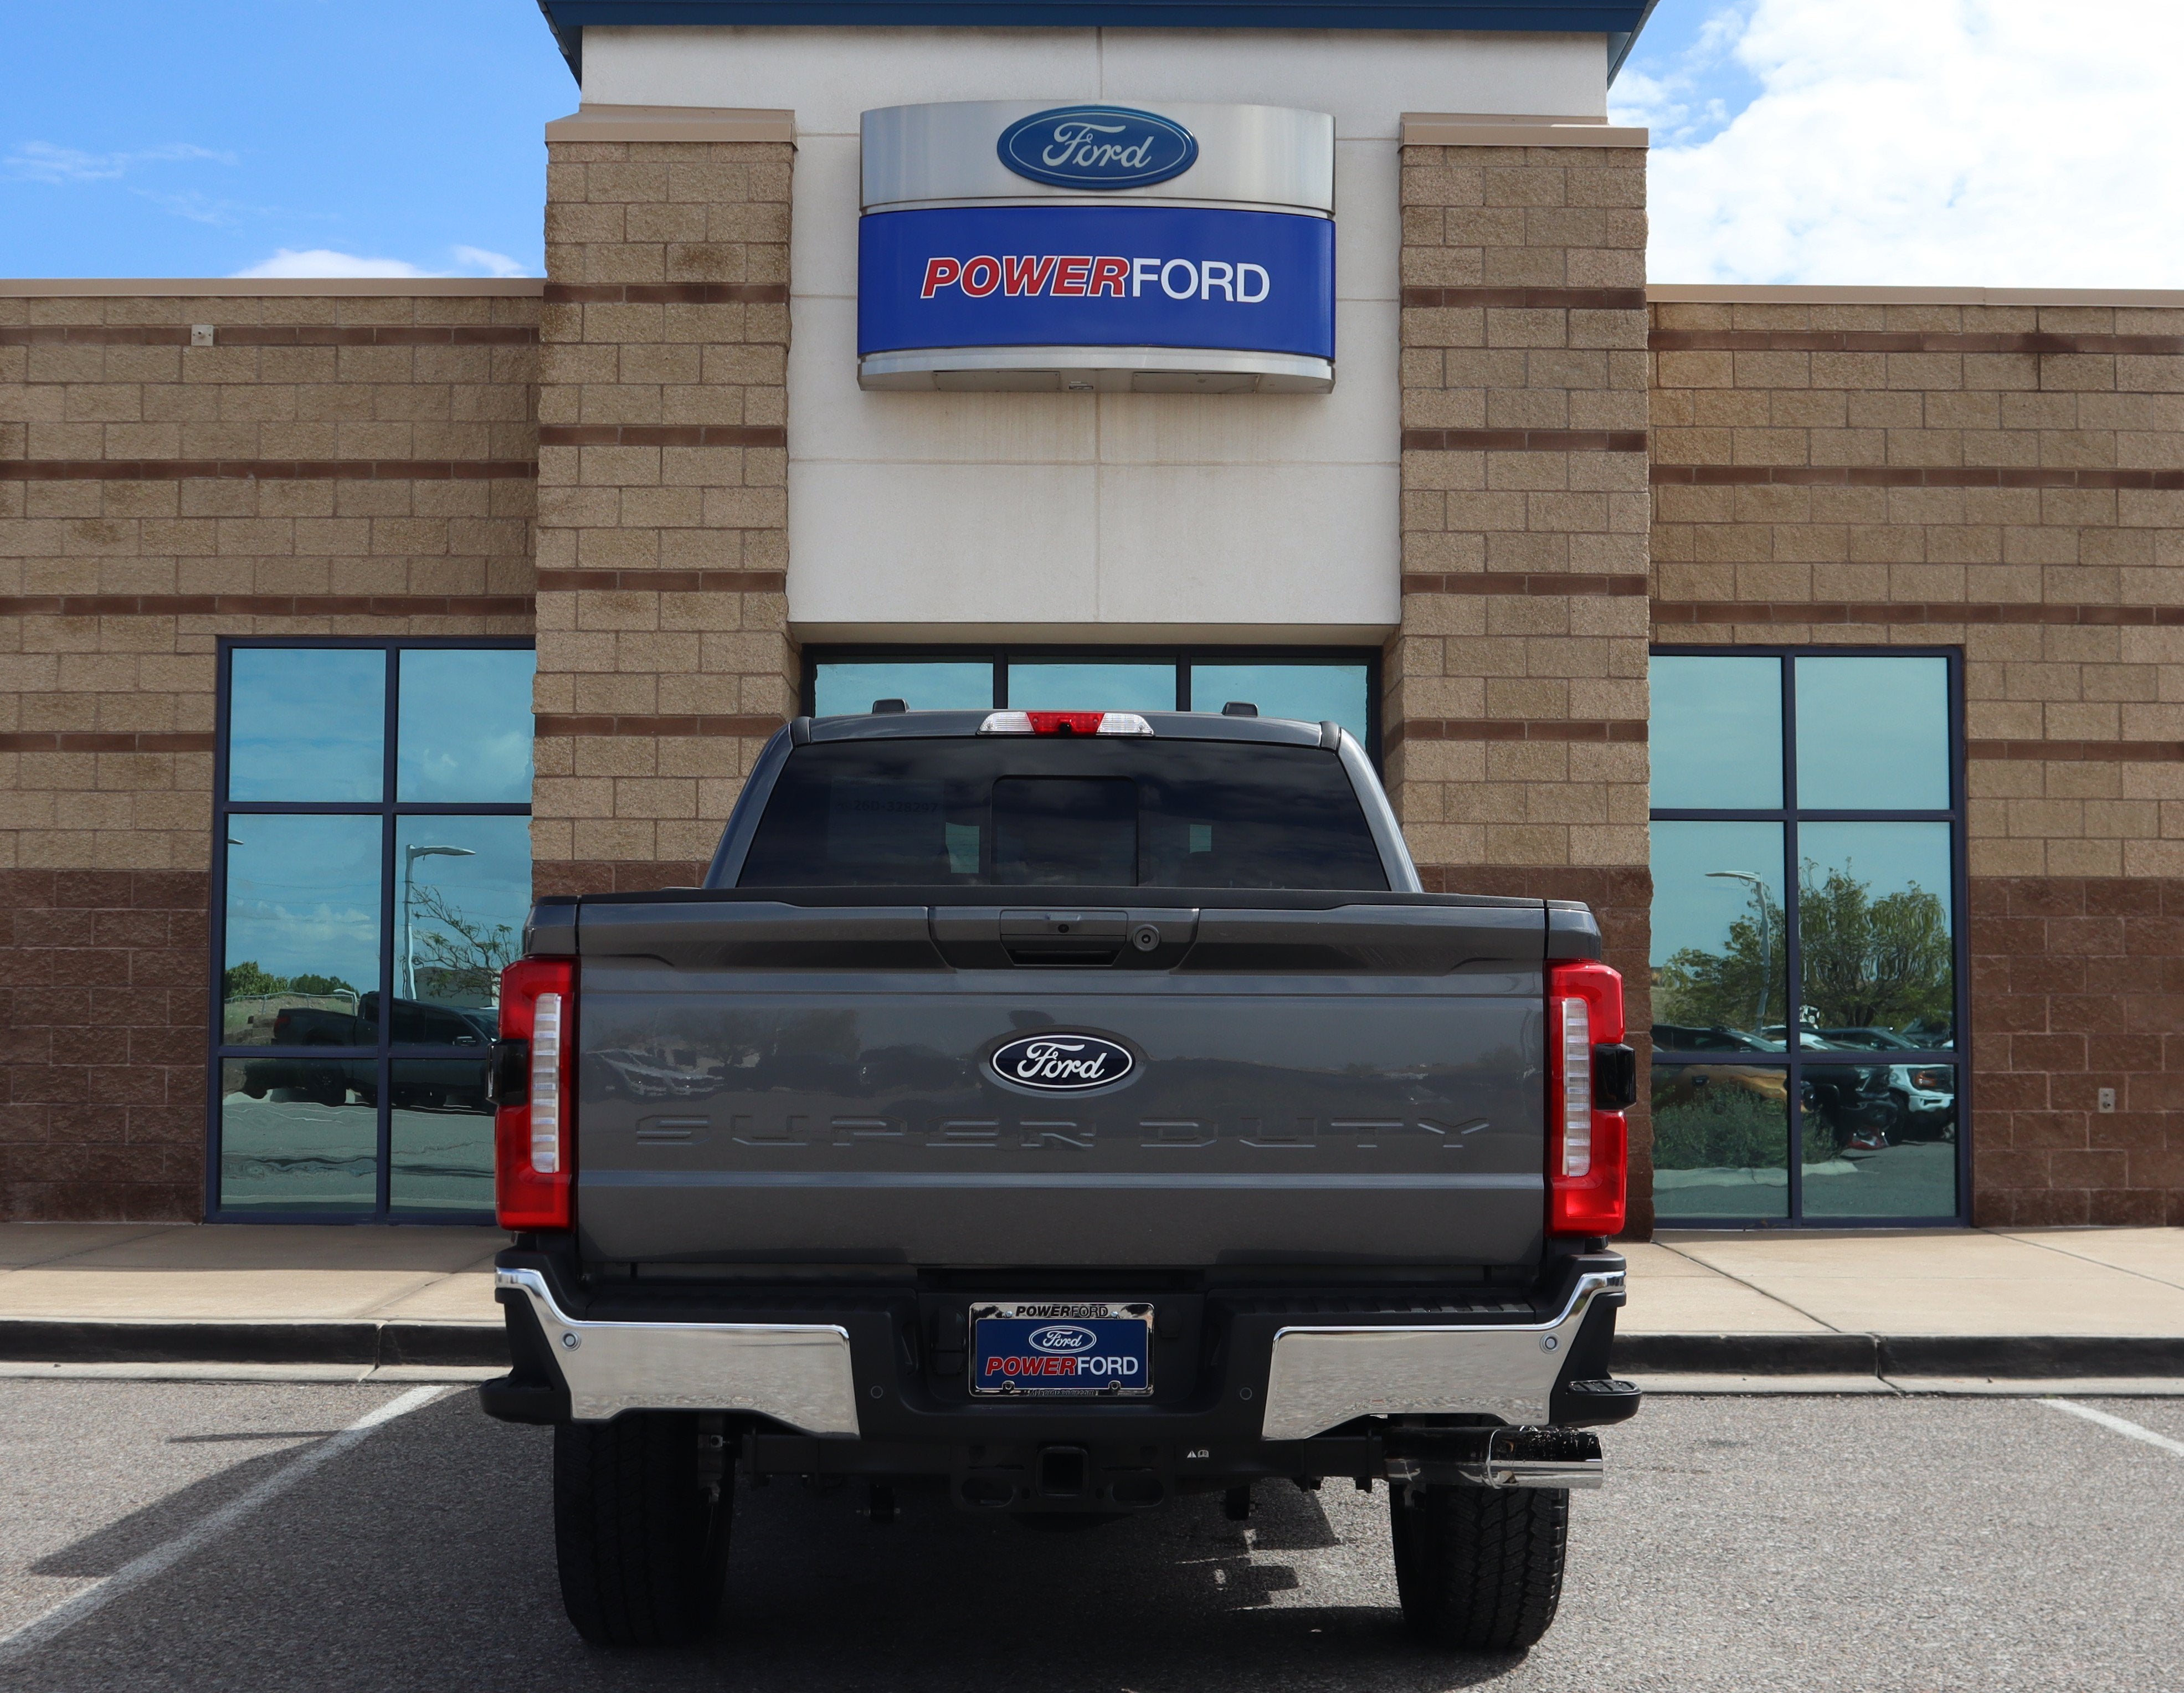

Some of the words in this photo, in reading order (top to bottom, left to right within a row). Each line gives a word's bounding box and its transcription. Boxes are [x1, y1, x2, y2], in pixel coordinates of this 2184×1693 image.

[1042, 121, 1155, 169] Ford
[920, 255, 1271, 303] POWERFORD
[1017, 1042, 1107, 1079] Ford
[637, 1114, 1096, 1147] SUPER
[1139, 1116, 1491, 1148] DUTY
[1015, 1305, 1108, 1317] POWERFORD
[1042, 1330, 1083, 1347] Ford
[985, 1356, 1139, 1376] POWERFORD
